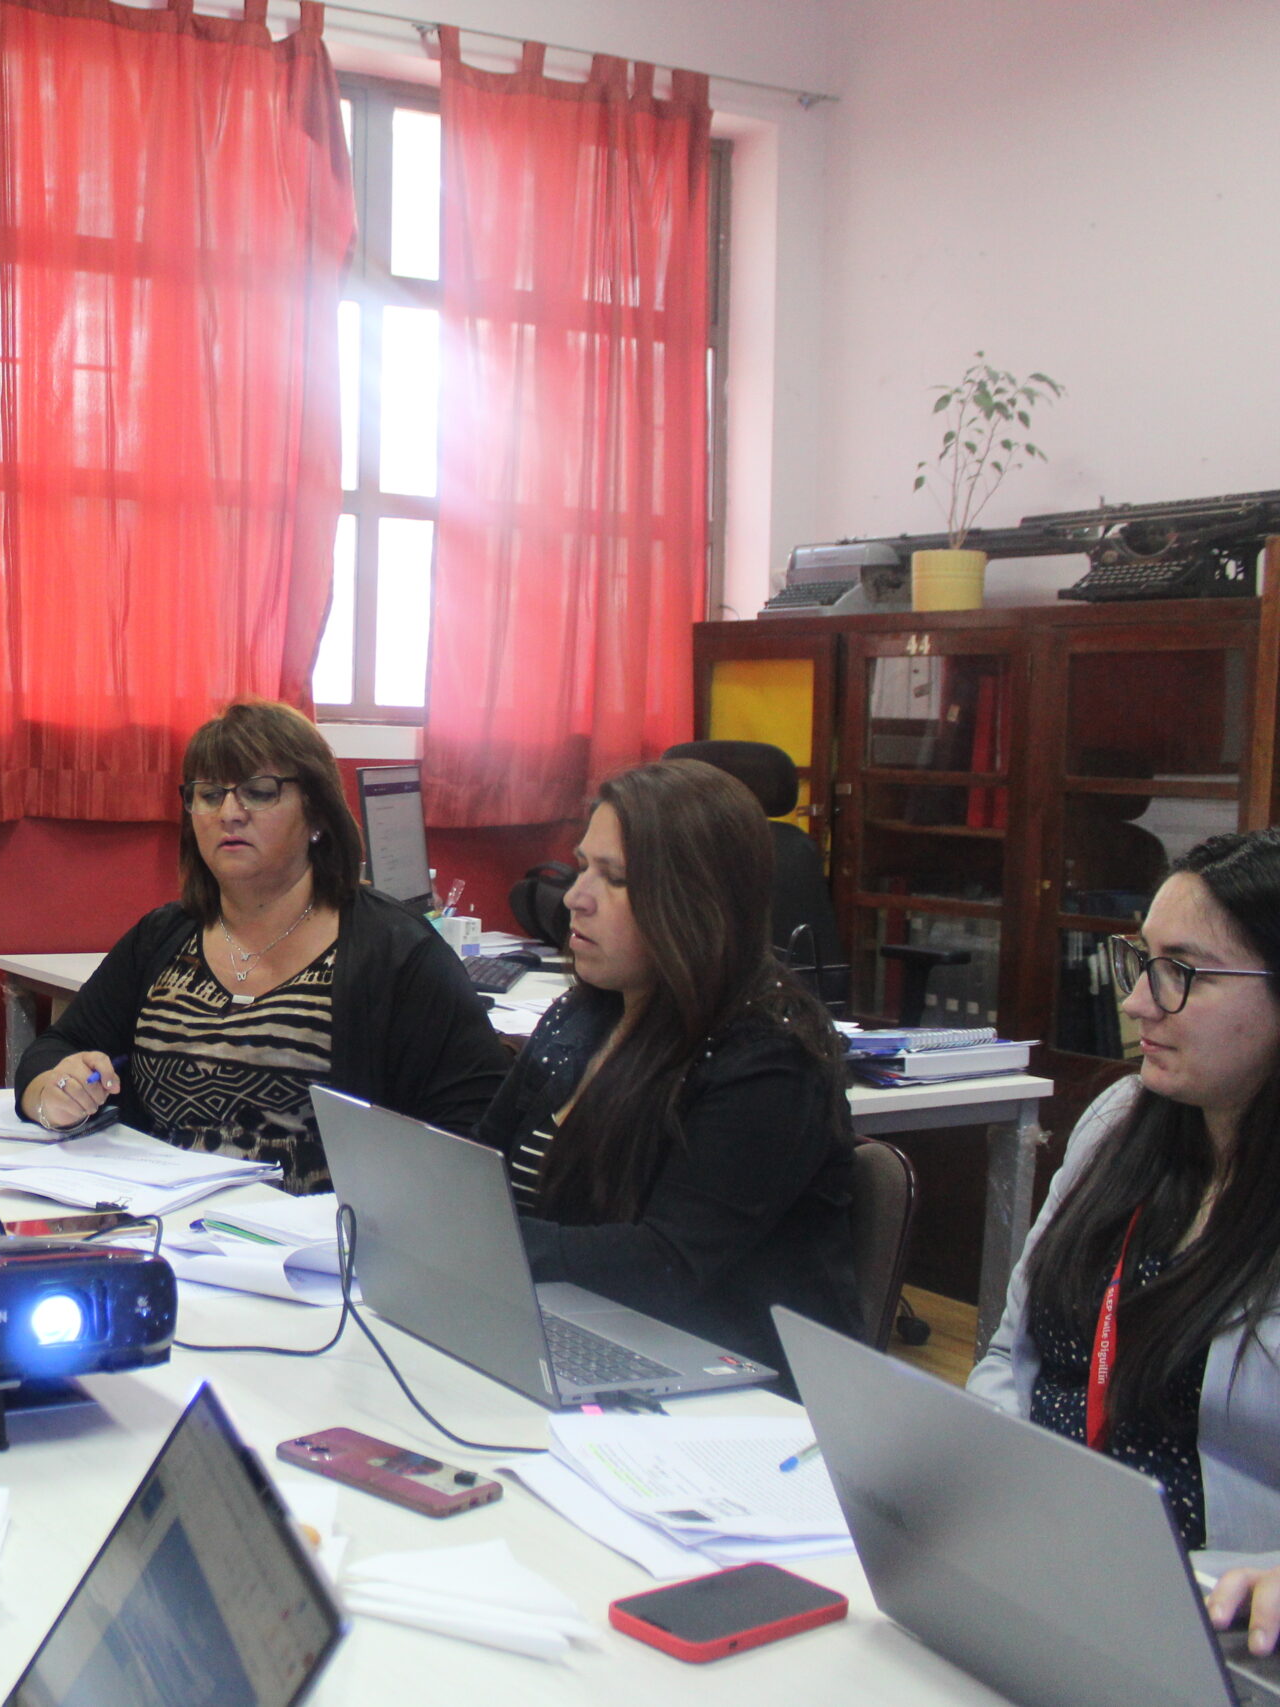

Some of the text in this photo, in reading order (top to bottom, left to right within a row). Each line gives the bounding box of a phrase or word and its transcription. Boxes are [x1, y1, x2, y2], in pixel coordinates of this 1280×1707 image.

[906, 634, 931, 655] 44
[1106, 1287, 1115, 1312] SLEP
[1102, 1313, 1113, 1339] Valle
